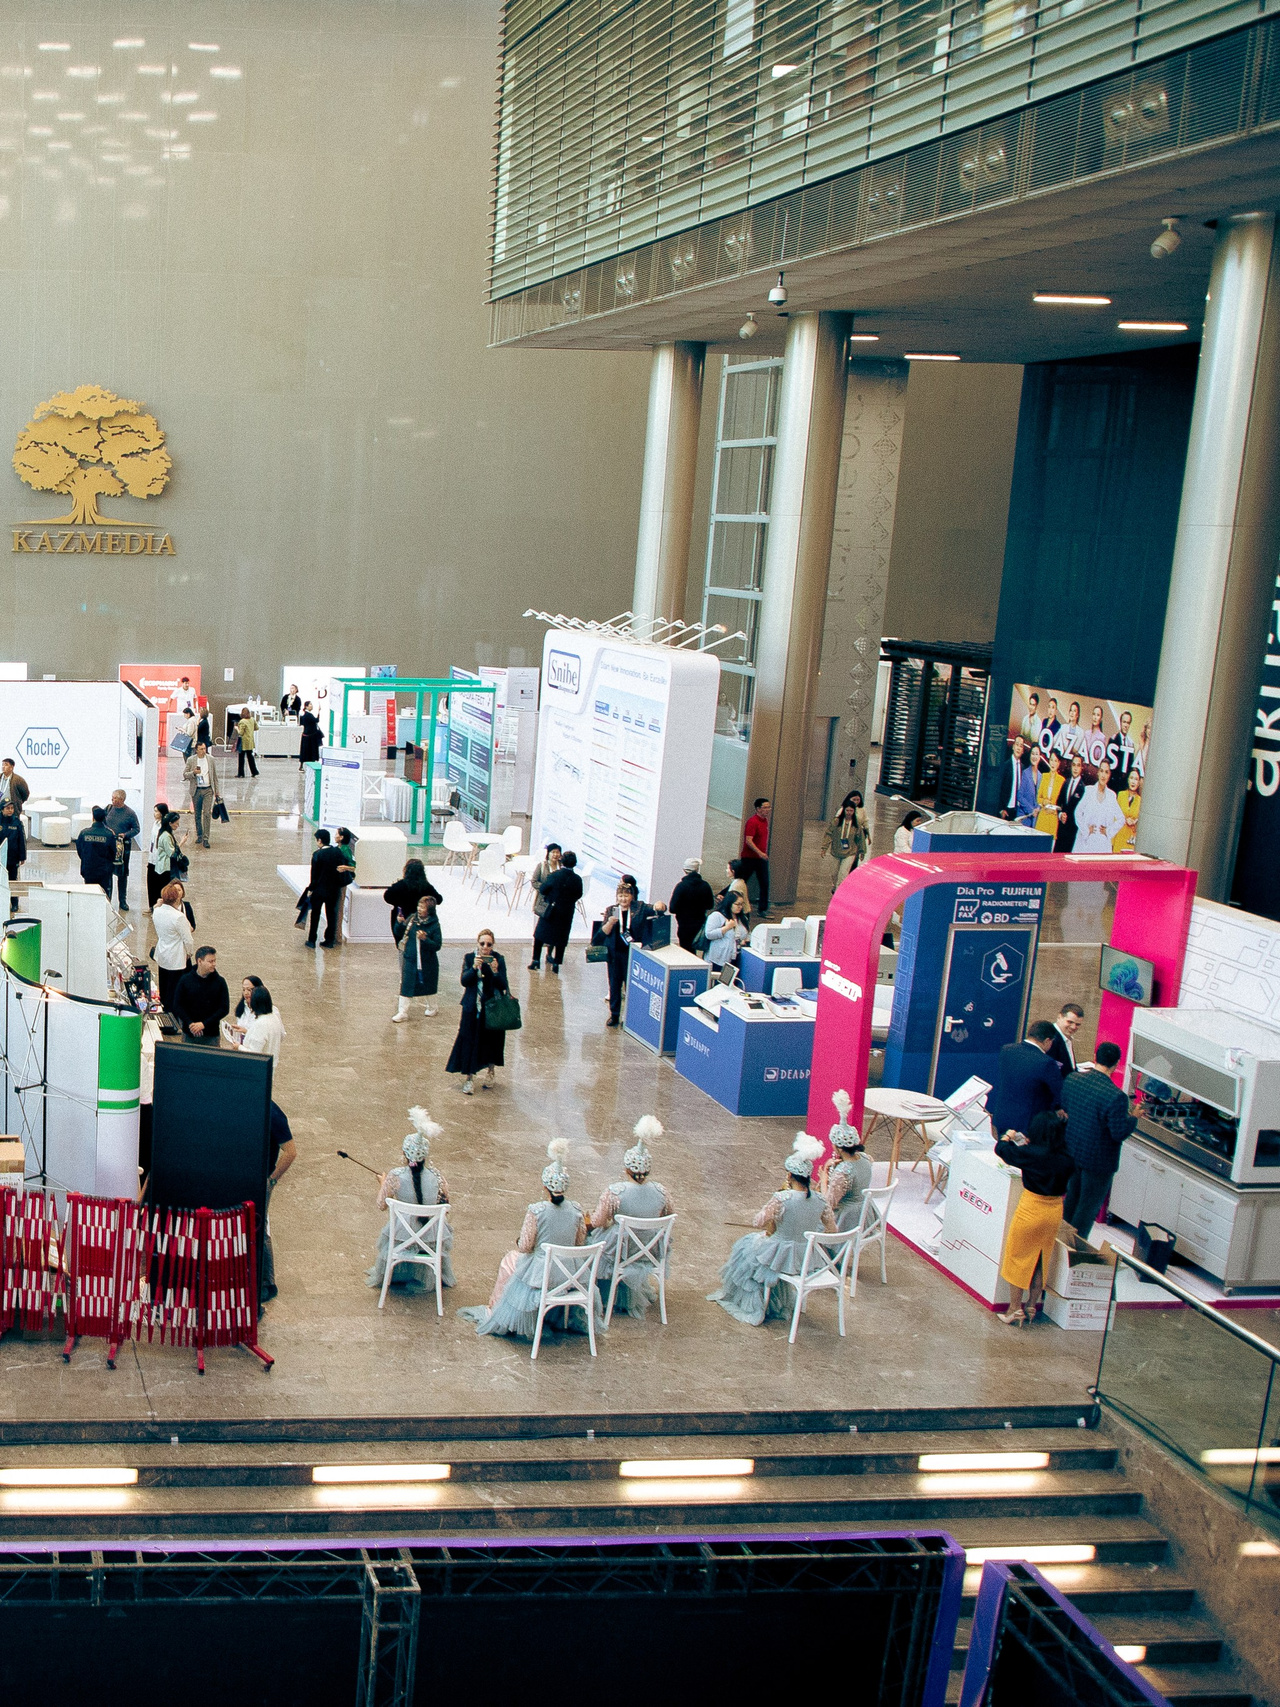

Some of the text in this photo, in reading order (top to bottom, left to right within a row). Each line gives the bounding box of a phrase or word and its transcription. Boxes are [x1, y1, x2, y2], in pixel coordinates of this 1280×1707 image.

[11, 530, 176, 555] KAZMEDIA
[26, 738, 61, 756] Roche
[956, 886, 995, 896] Dia Pro
[1001, 886, 1042, 896] FUJIFILM
[993, 913, 1010, 923] BD
[963, 1190, 989, 1212] БЕСТ
